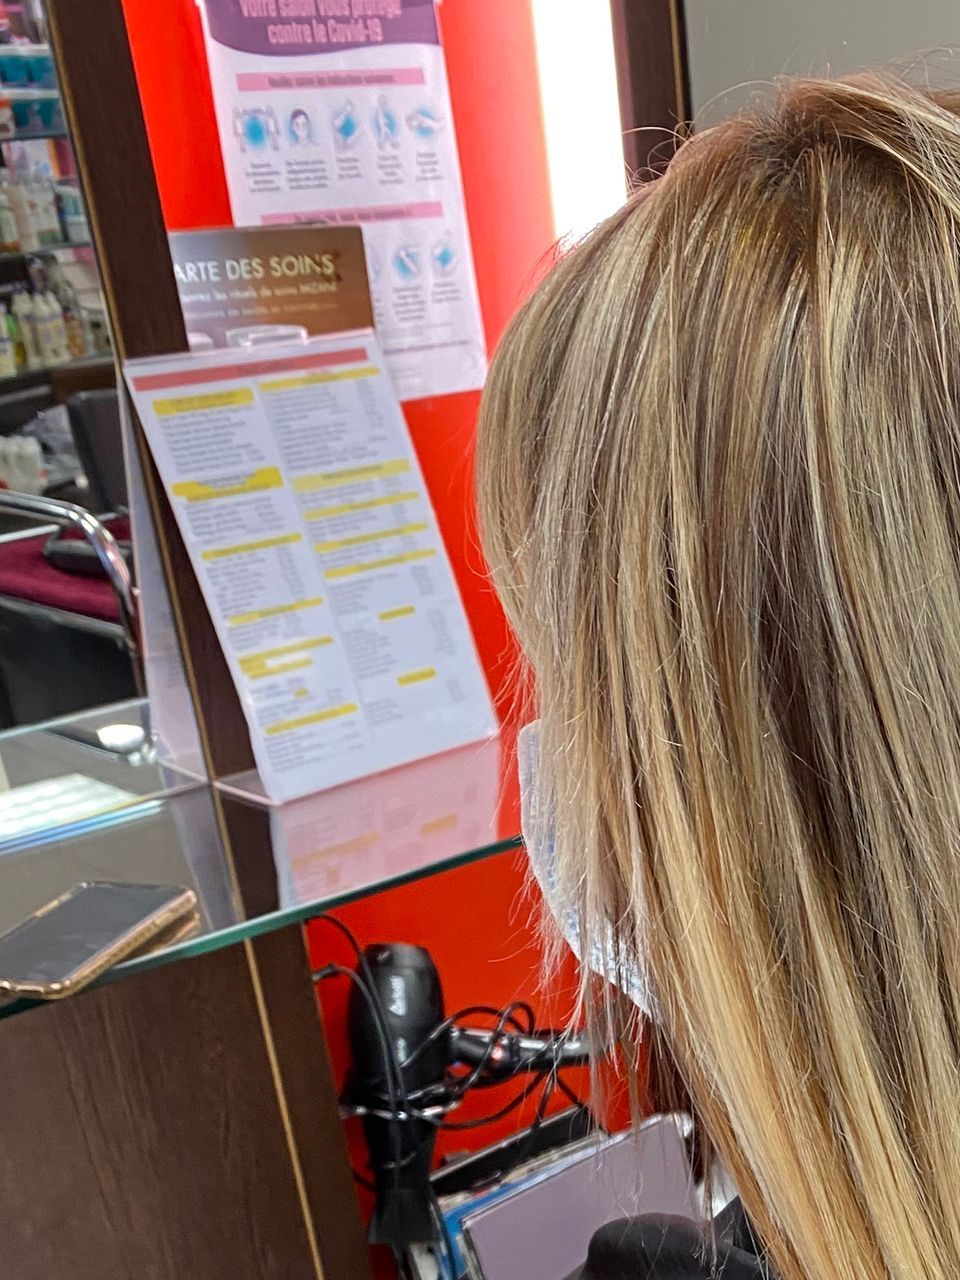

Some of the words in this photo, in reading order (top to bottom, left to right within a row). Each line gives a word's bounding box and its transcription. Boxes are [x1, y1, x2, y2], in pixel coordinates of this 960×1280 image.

[267, 21, 313, 45] contre
[311, 18, 328, 43] le
[327, 17, 384, 43] Covid-19
[174, 261, 221, 283] ARTE
[225, 258, 265, 281] DES
[270, 253, 335, 277] SOINS
